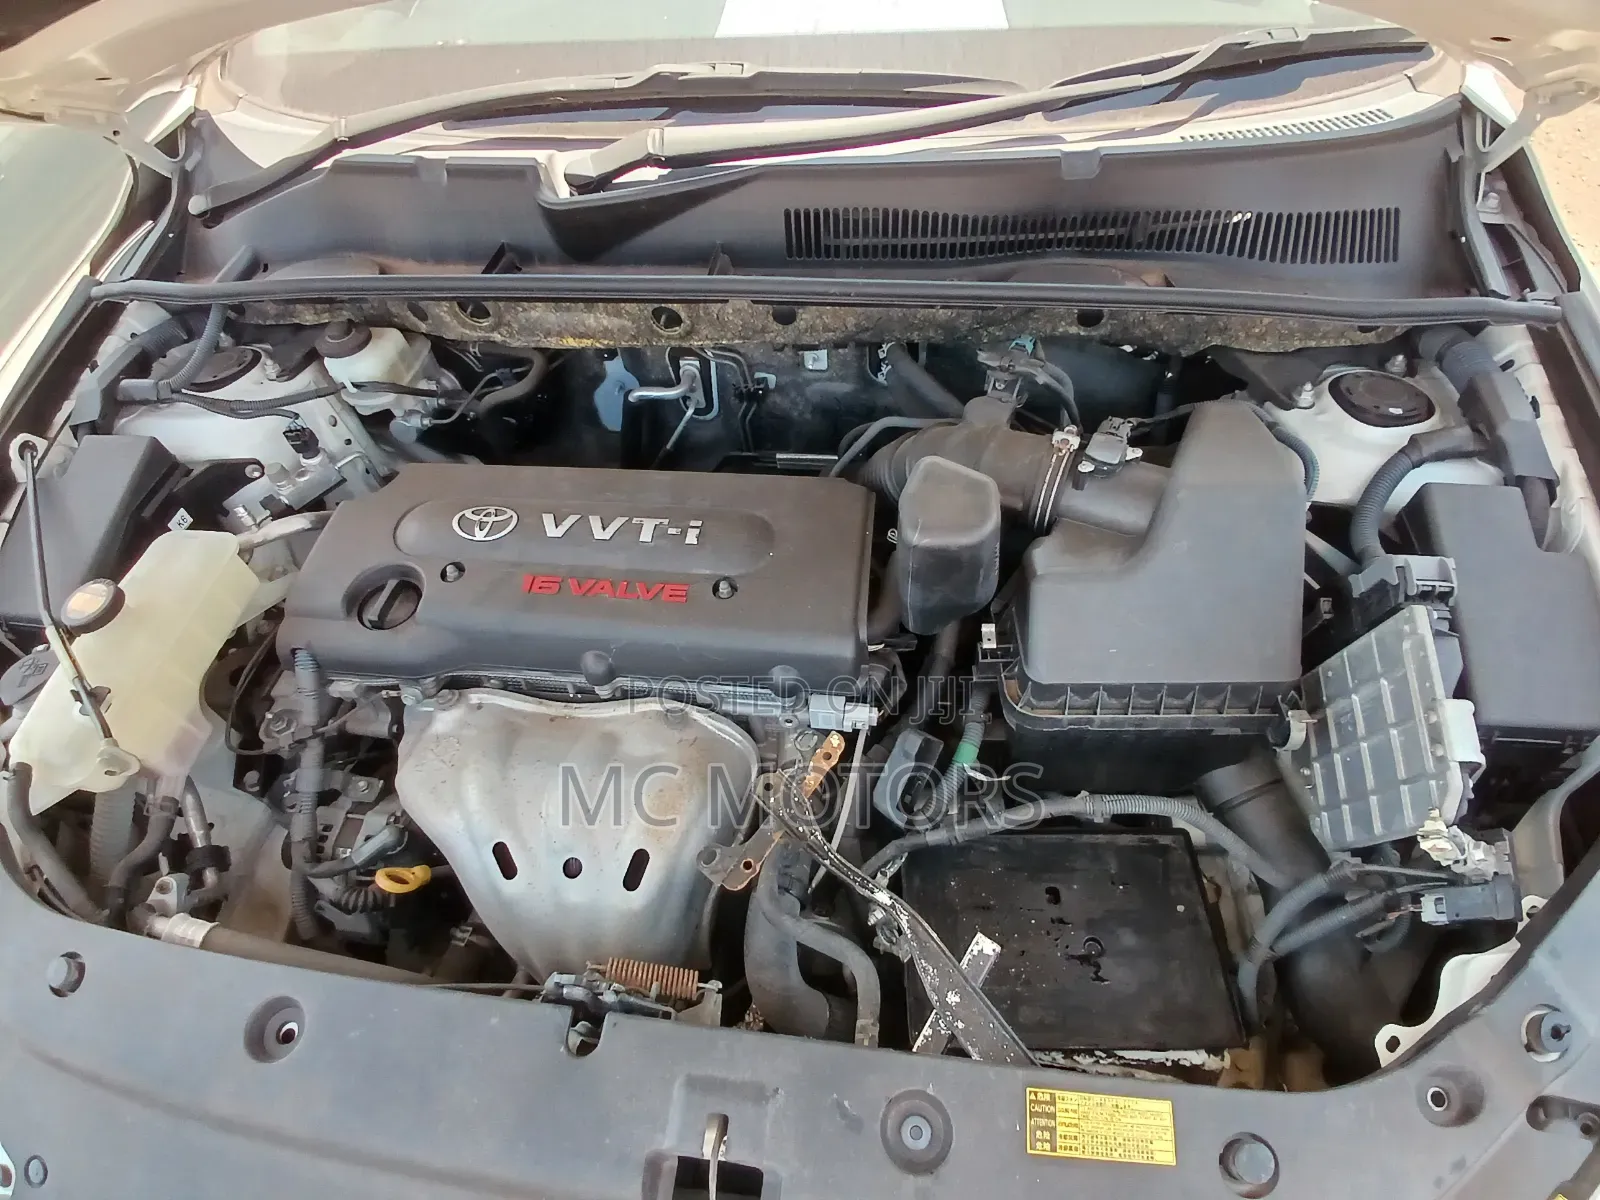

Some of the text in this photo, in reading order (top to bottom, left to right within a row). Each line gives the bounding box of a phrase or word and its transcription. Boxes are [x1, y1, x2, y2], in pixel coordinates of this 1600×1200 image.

[176, 515, 188, 529] K6
[541, 512, 703, 545] VVT-i
[521, 574, 691, 603] 16 VALVE
[1030, 1103, 1056, 1113] CAUTION
[1031, 1117, 1056, 1128] ATTENTION
